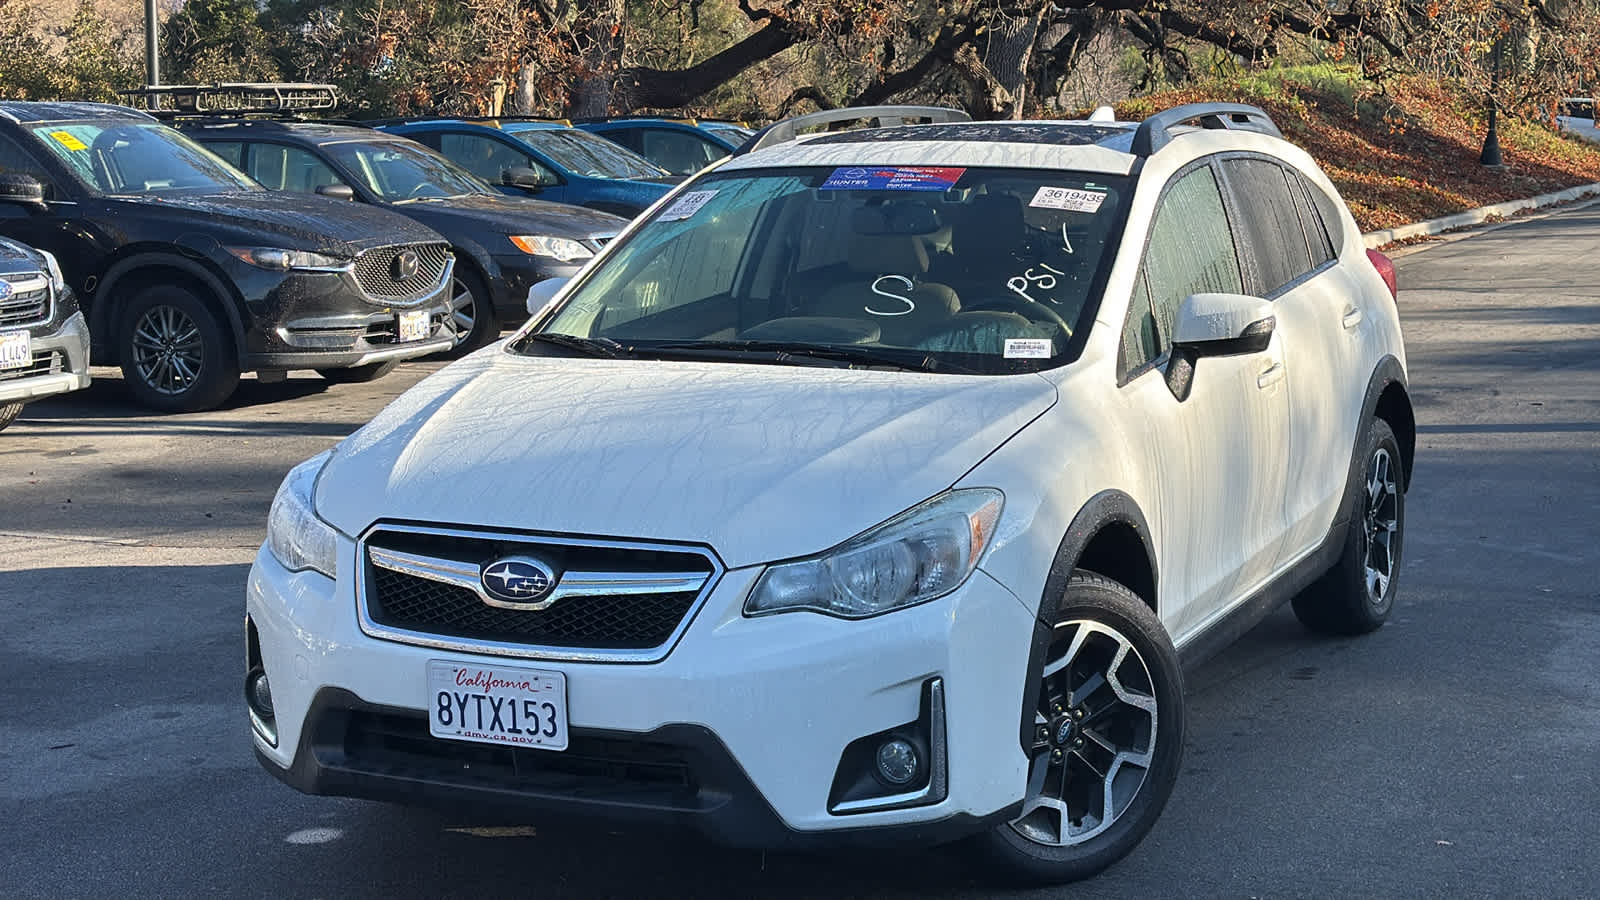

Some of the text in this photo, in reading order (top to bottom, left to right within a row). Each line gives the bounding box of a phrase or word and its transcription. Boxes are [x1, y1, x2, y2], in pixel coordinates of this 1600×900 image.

[864, 274, 915, 316] S
[455, 668, 540, 693] California
[437, 691, 558, 738] 8YTX153
[464, 731, 534, 744] dmv.ca.gov
